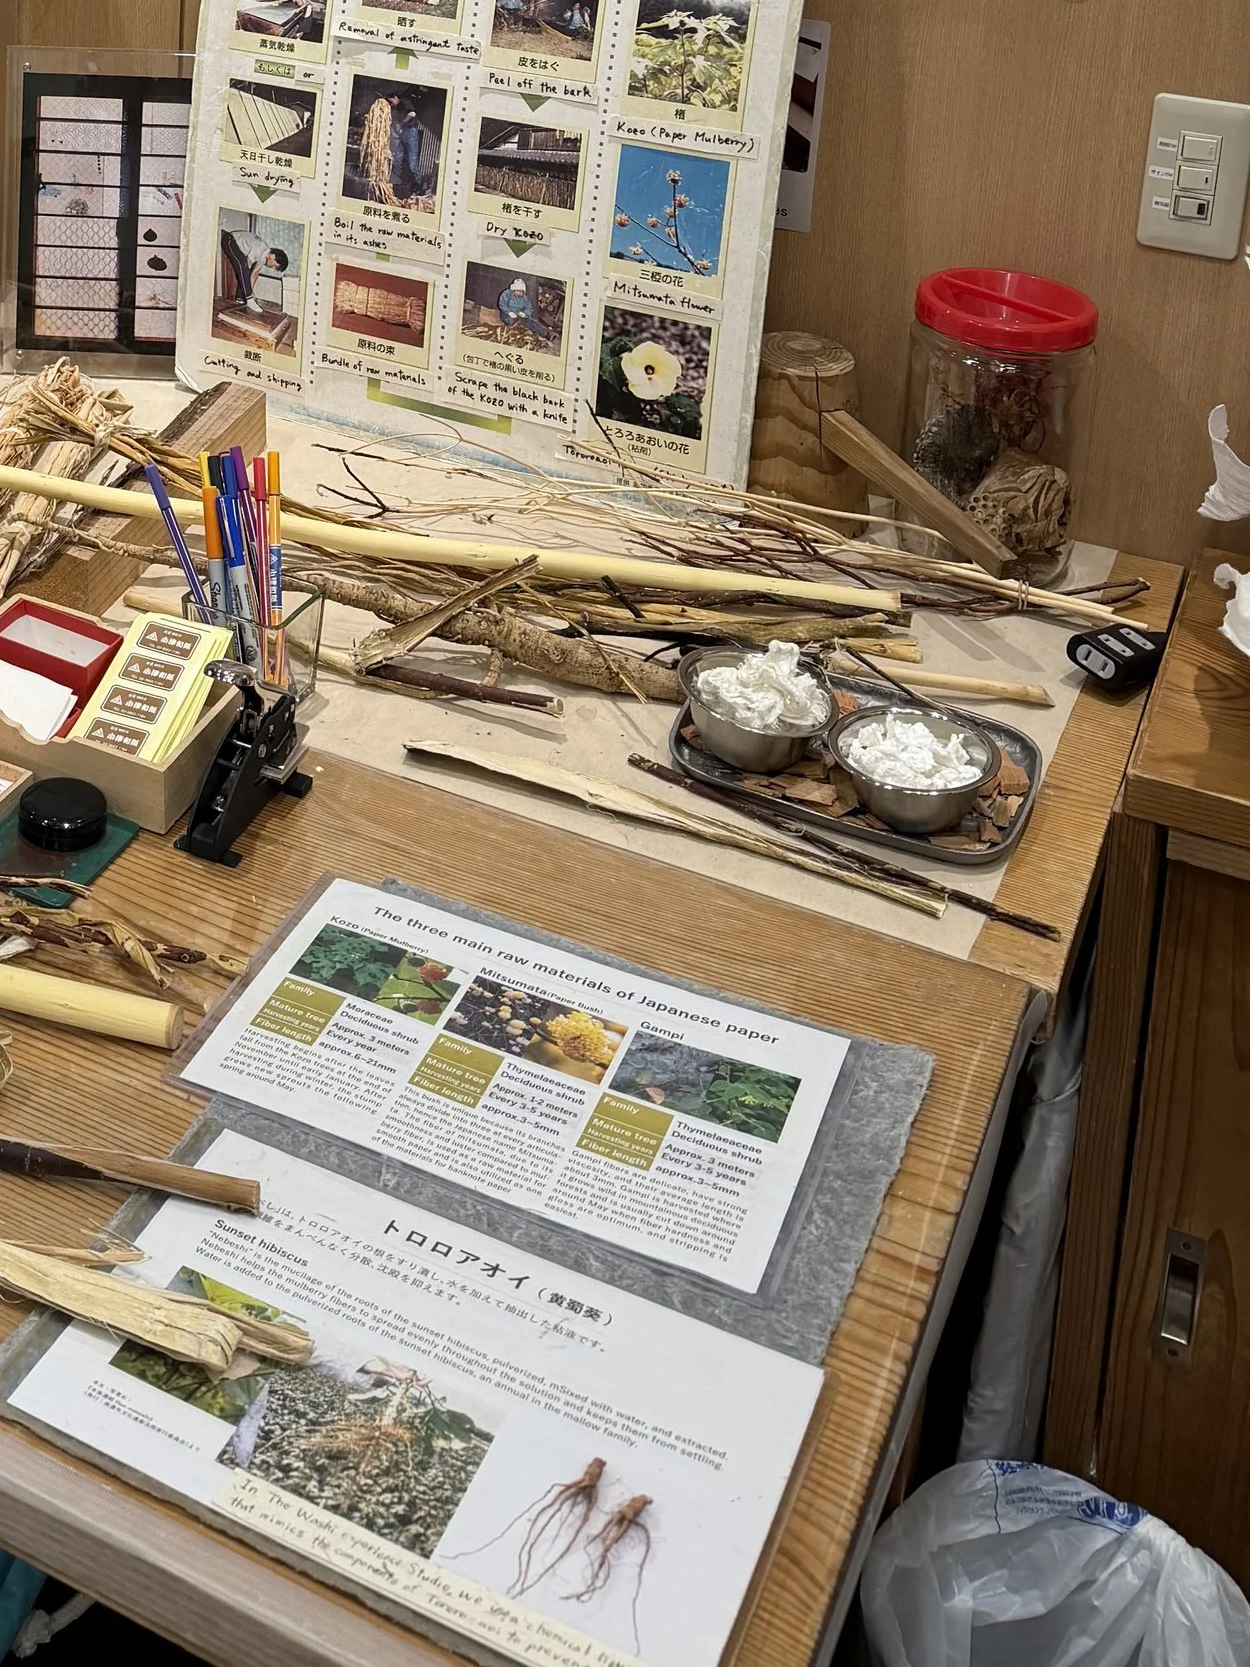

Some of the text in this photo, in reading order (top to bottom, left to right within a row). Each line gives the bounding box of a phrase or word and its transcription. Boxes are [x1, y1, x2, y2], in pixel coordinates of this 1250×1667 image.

[257, 62, 292, 76] もしくは
[517, 55, 560, 72] 皮をはぐ
[493, 349, 525, 366] へぐる
[330, 915, 360, 931] Kozo
[374, 905, 781, 1045] The three main raw materials of Japanese paper
[640, 1020, 686, 1041] Gampi
[214, 1219, 309, 1268] Sunset hibiscus
